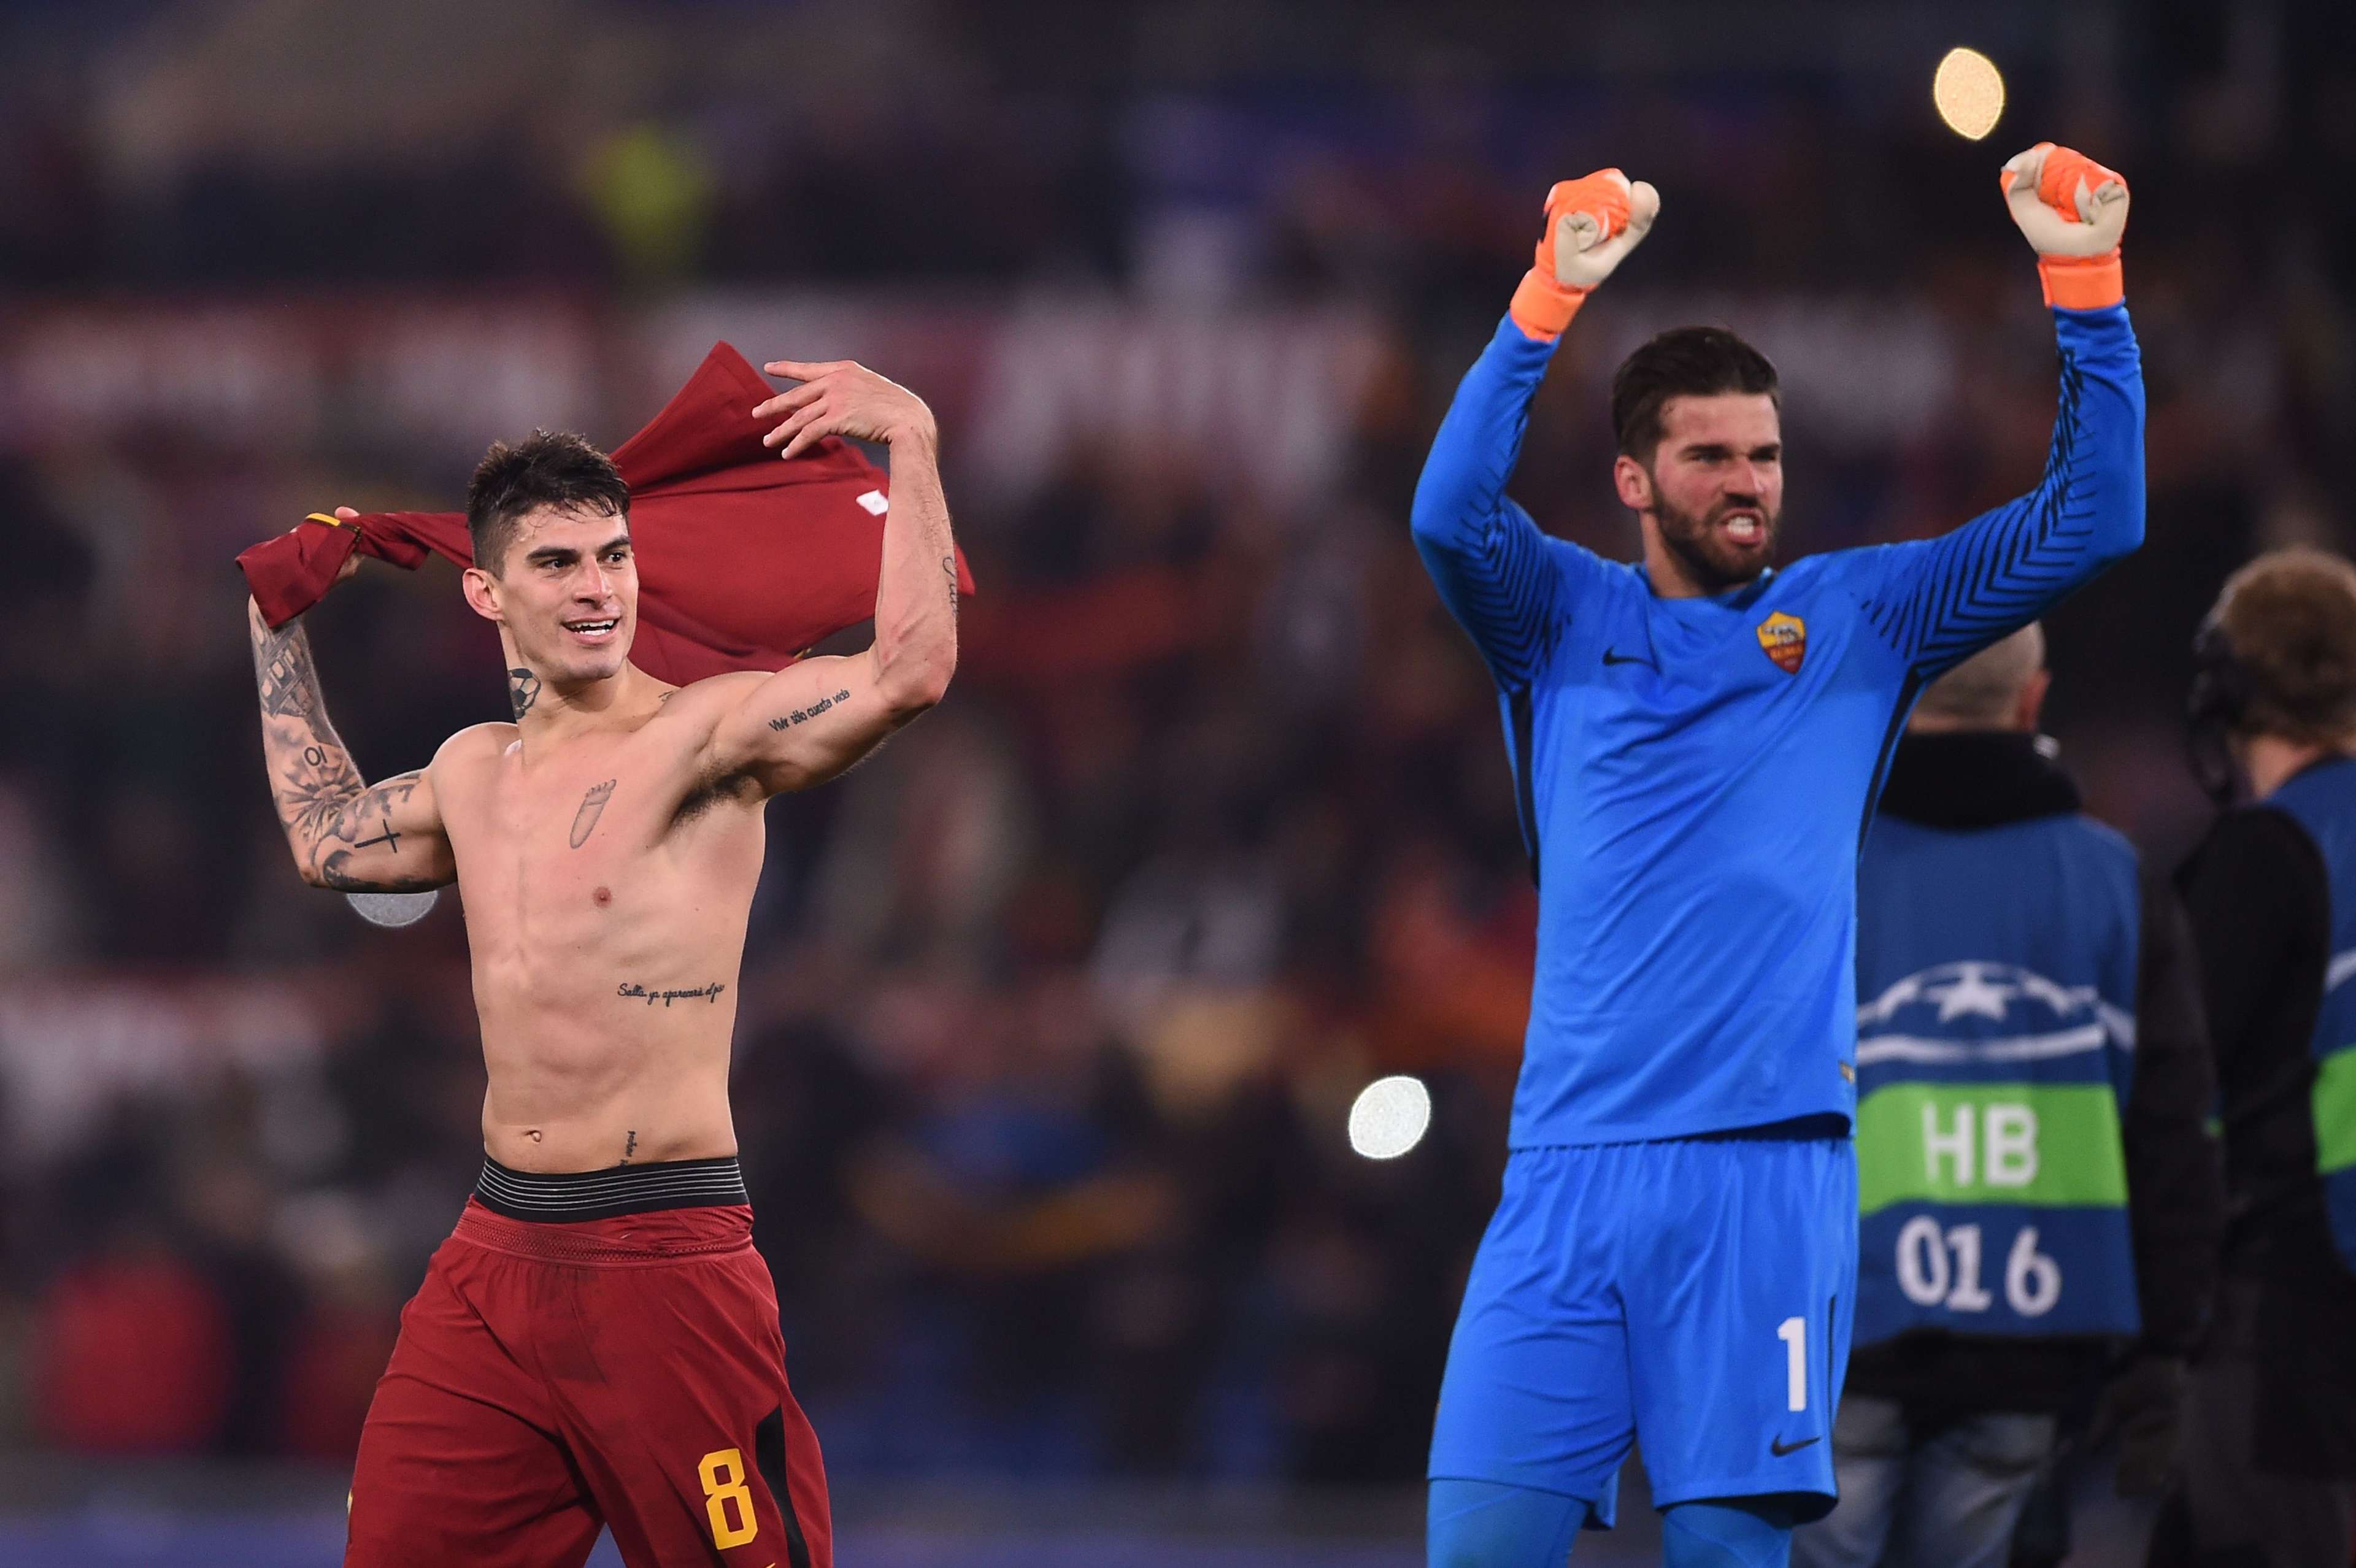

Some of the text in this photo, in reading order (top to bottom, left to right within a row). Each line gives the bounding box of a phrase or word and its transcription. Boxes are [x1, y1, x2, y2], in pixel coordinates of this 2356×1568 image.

[807, 698, 833, 717] cuesta
[832, 688, 850, 704] vida
[1921, 1101, 2041, 1188] HB
[1895, 1215, 2063, 1318] 016
[1777, 1316, 1807, 1412] 1
[698, 1448, 758, 1550] 8
